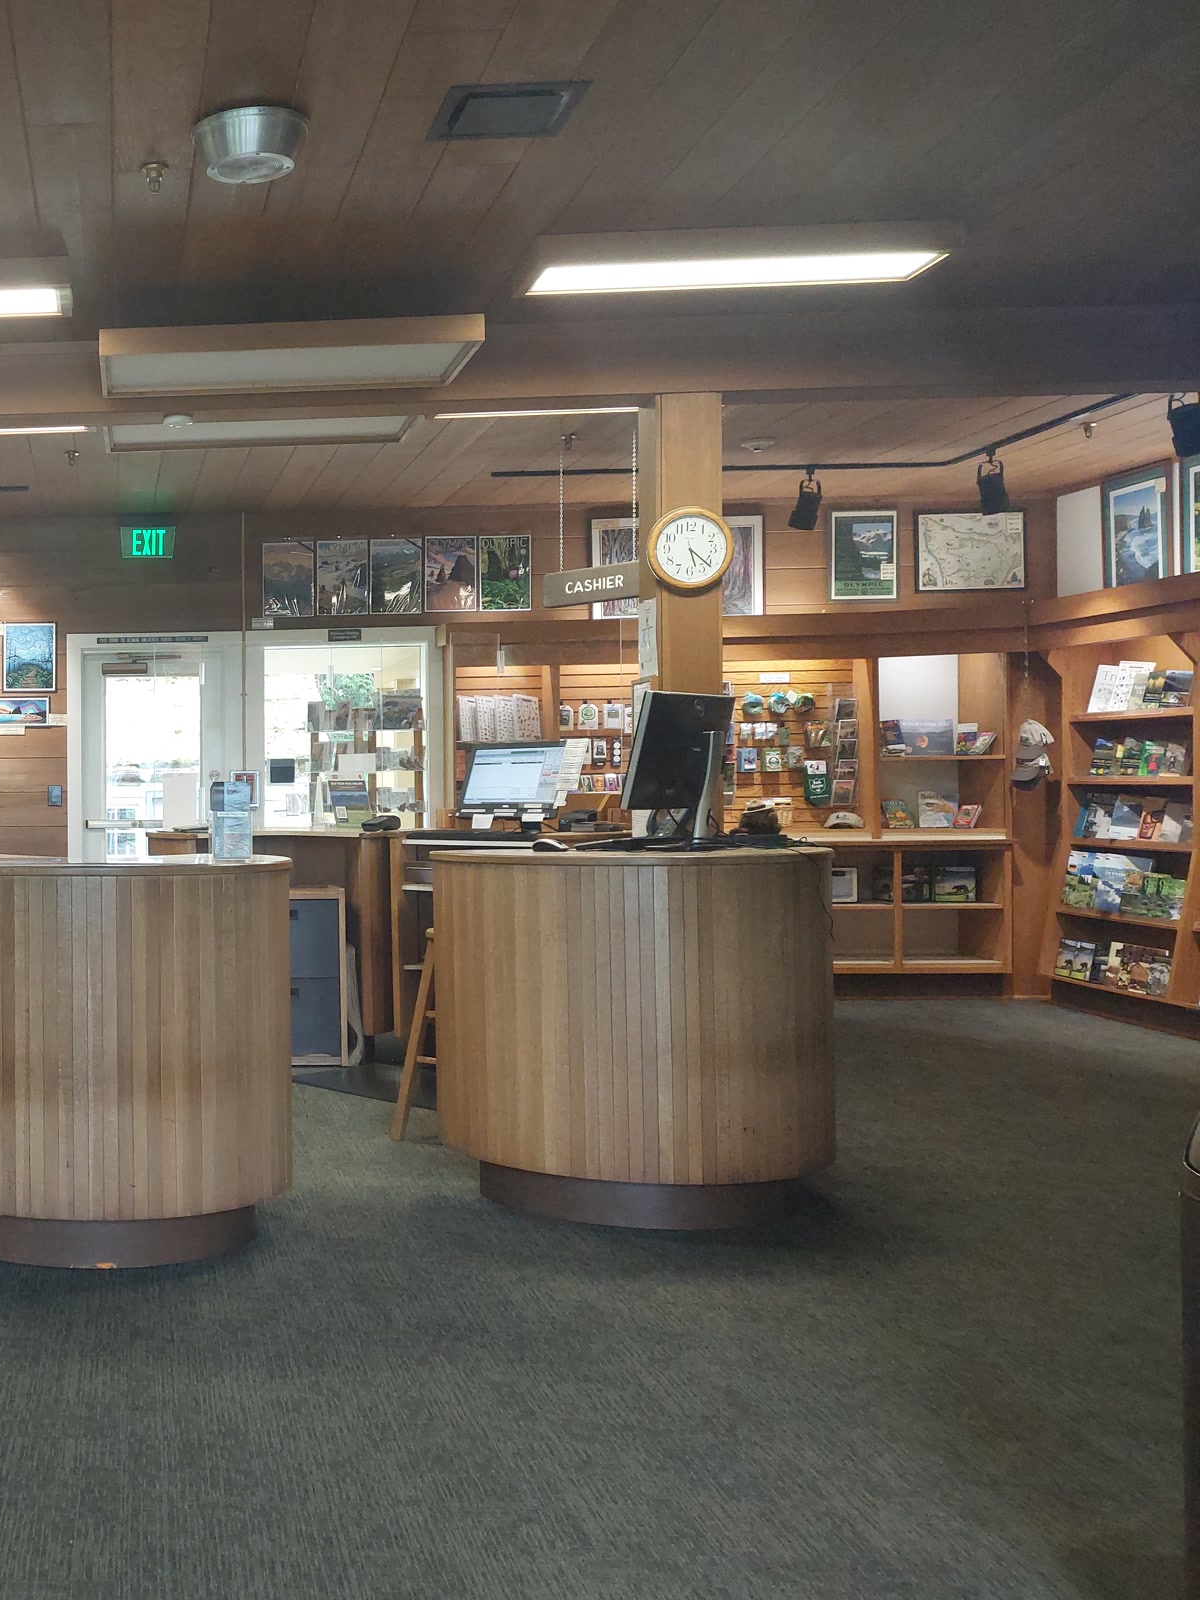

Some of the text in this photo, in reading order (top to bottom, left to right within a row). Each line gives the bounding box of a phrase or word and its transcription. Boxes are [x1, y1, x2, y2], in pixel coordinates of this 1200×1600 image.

[676, 523, 684, 535] 11
[687, 521, 697, 532] 12
[701, 524, 705, 535] 1
[132, 529, 166, 556] EXIT
[428, 538, 472, 548] OLYMPIC
[482, 537, 528, 549] OLYMPIC
[666, 533, 676, 543] 10
[708, 532, 716, 543] 2
[663, 544, 671, 554] 9
[710, 543, 718, 554] 3
[666, 556, 674, 566] 8
[675, 563, 682, 574] 7
[685, 566, 694, 577] 6
[698, 563, 706, 574] 5
[565, 574, 624, 594] CASHIER
